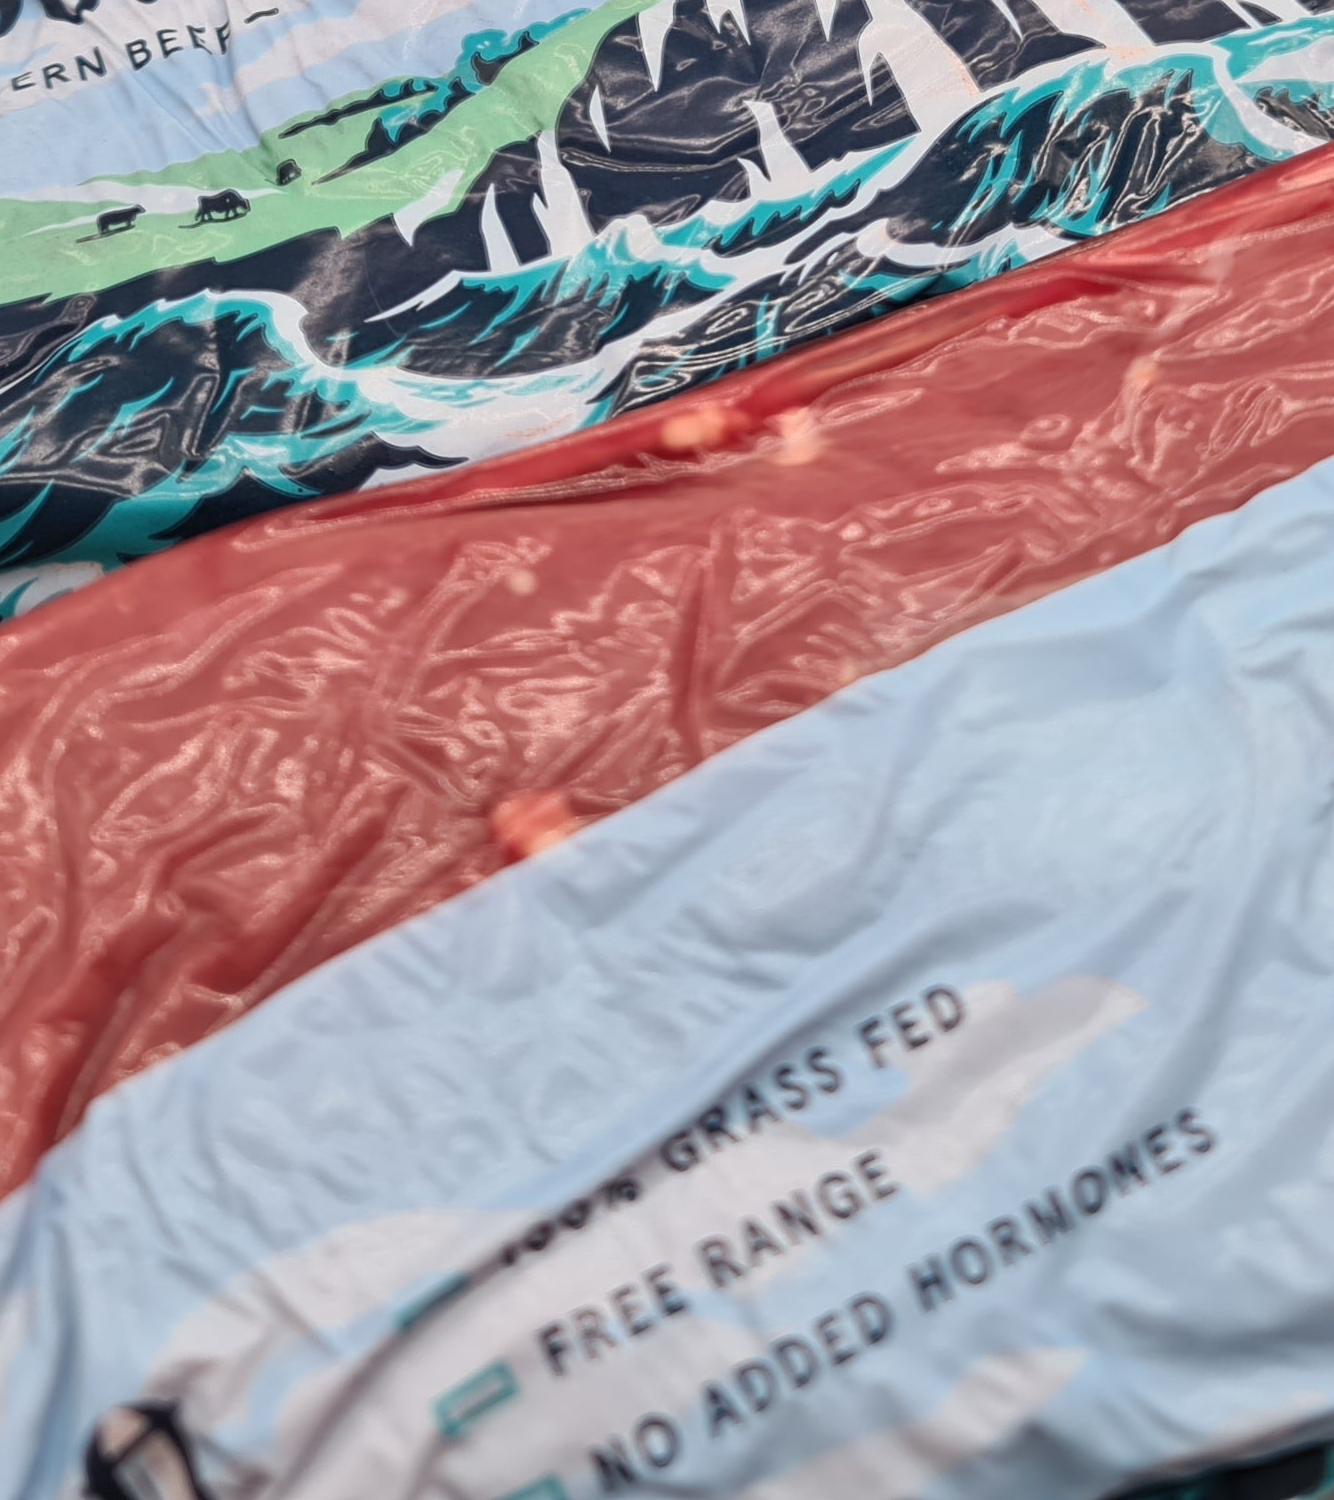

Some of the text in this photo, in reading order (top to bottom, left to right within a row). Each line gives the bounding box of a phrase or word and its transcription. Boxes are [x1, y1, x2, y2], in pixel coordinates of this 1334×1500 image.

[662, 1044, 843, 1173] GRASS
[857, 983, 965, 1069] FED
[538, 1152, 901, 1375] FREE RANGE
[589, 1109, 1221, 1495] NO ADDED HORMONES
